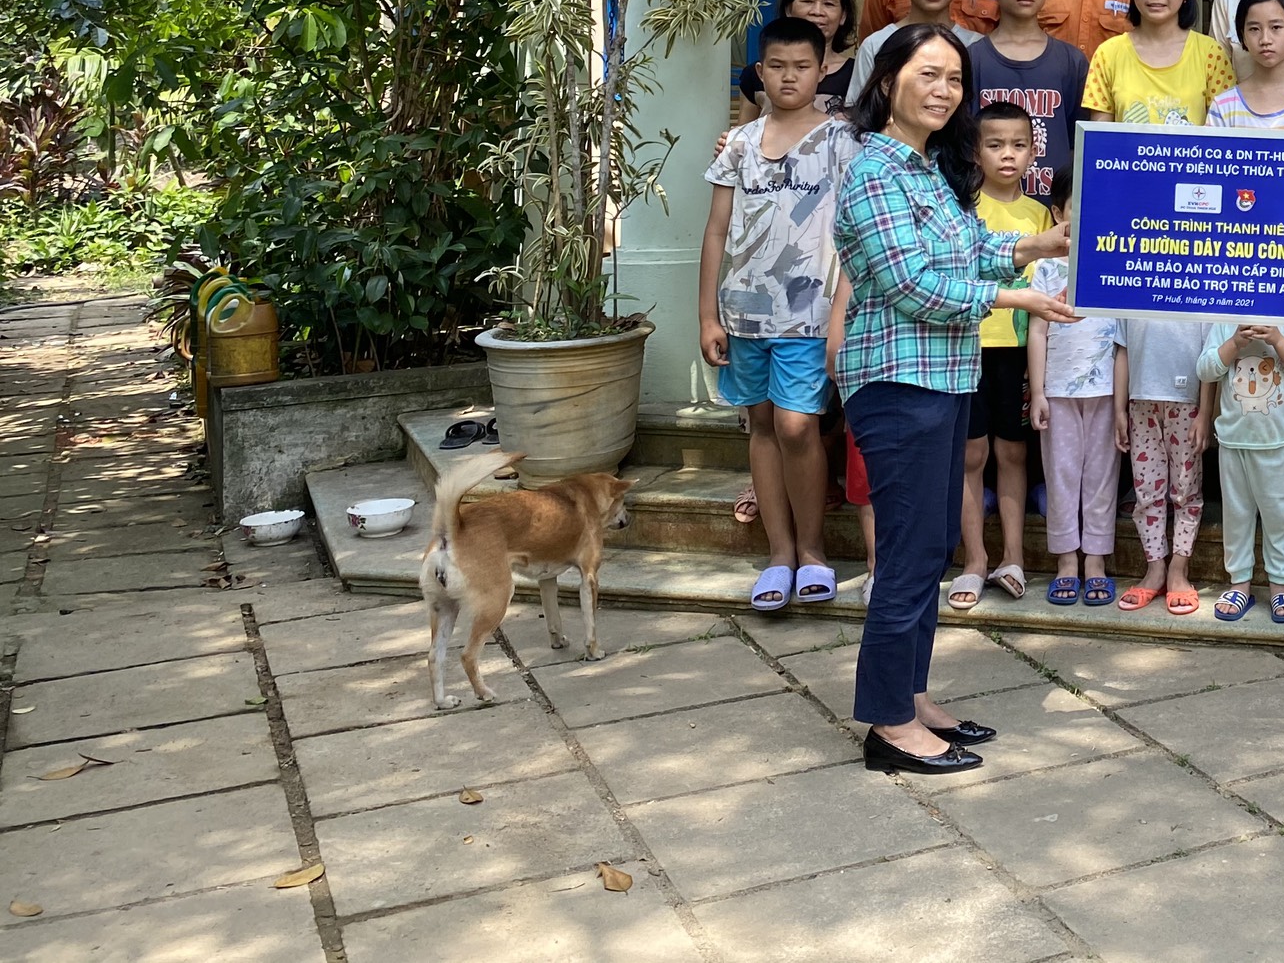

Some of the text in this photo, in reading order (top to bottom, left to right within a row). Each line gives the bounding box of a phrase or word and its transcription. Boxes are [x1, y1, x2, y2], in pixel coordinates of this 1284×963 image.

[1137, 144, 1171, 157] ĐOÀN
[1174, 145, 1202, 158] KHỐI
[1205, 149, 1222, 159] CQ
[1225, 149, 1233, 159] &
[1236, 150, 1252, 160] DN
[1096, 158, 1129, 171] ĐOÀN
[1132, 159, 1166, 172] CÔNG
[1169, 162, 1183, 172] TY
[1186, 162, 1213, 175] ĐIỆN
[1216, 164, 1239, 177] LỰC
[1242, 165, 1274, 177] THỪA
[1131, 217, 1169, 231] CÔNG
[1173, 218, 1212, 232] TRÌNH
[1215, 222, 1260, 235] THANH
[1096, 231, 1118, 252] XỬ
[1119, 234, 1136, 253] LÝ
[1140, 235, 1190, 255] ĐƯỜNG
[1193, 237, 1222, 257] DÂY
[1225, 241, 1254, 258] SAU
[1126, 258, 1153, 271] ĐẢM
[1156, 259, 1182, 272] BẢO
[1185, 263, 1202, 274] AN
[1205, 262, 1239, 276] TOÀN
[1242, 263, 1267, 277] CẤP
[1100, 275, 1142, 287] TRUNG
[1145, 276, 1171, 288] TÂM
[1174, 276, 1200, 290] BẢO
[1203, 279, 1228, 294] TRỢ
[1231, 279, 1255, 293] TRẺ
[1258, 282, 1276, 294] EM
[1152, 294, 1163, 302] TP
[1185, 296, 1207, 306] tháng
[1209, 297, 1215, 305] 3
[1216, 298, 1233, 306] năm
[1235, 299, 1254, 307] 2021
